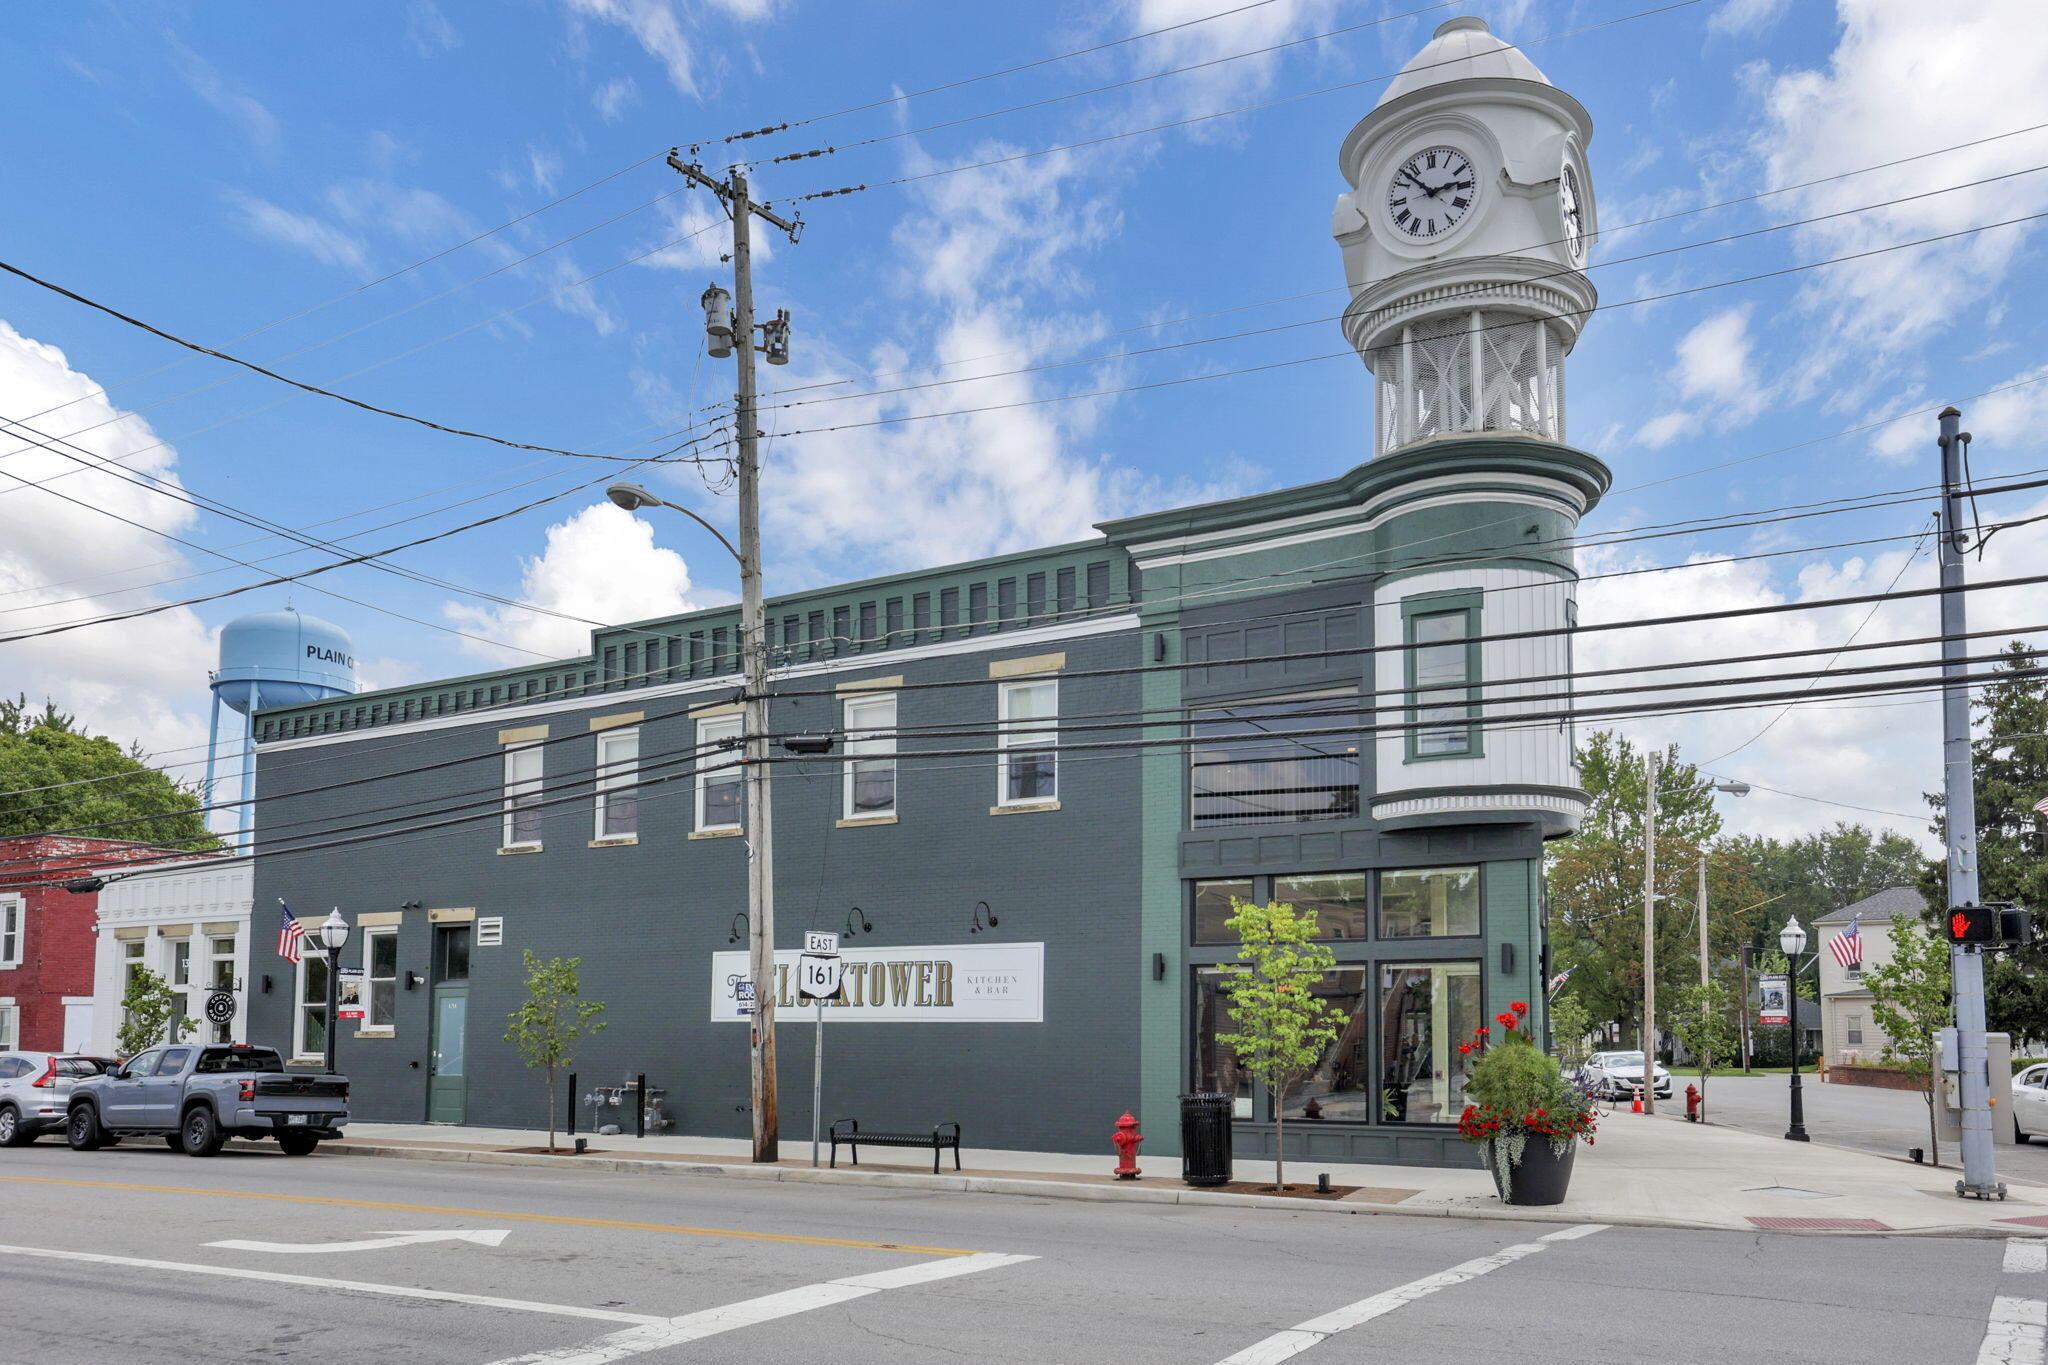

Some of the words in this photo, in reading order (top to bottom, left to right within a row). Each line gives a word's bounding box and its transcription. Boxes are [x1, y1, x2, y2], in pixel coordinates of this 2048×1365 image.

[307, 645, 345, 665] PLAIN
[810, 936, 833, 950] EAST
[808, 964, 833, 986] 161
[967, 975, 1017, 984] KITCHEN
[987, 986, 1008, 994] BAR
[211, 994, 233, 1006] COFFEE
[208, 1009, 233, 1021] PASTRIES
